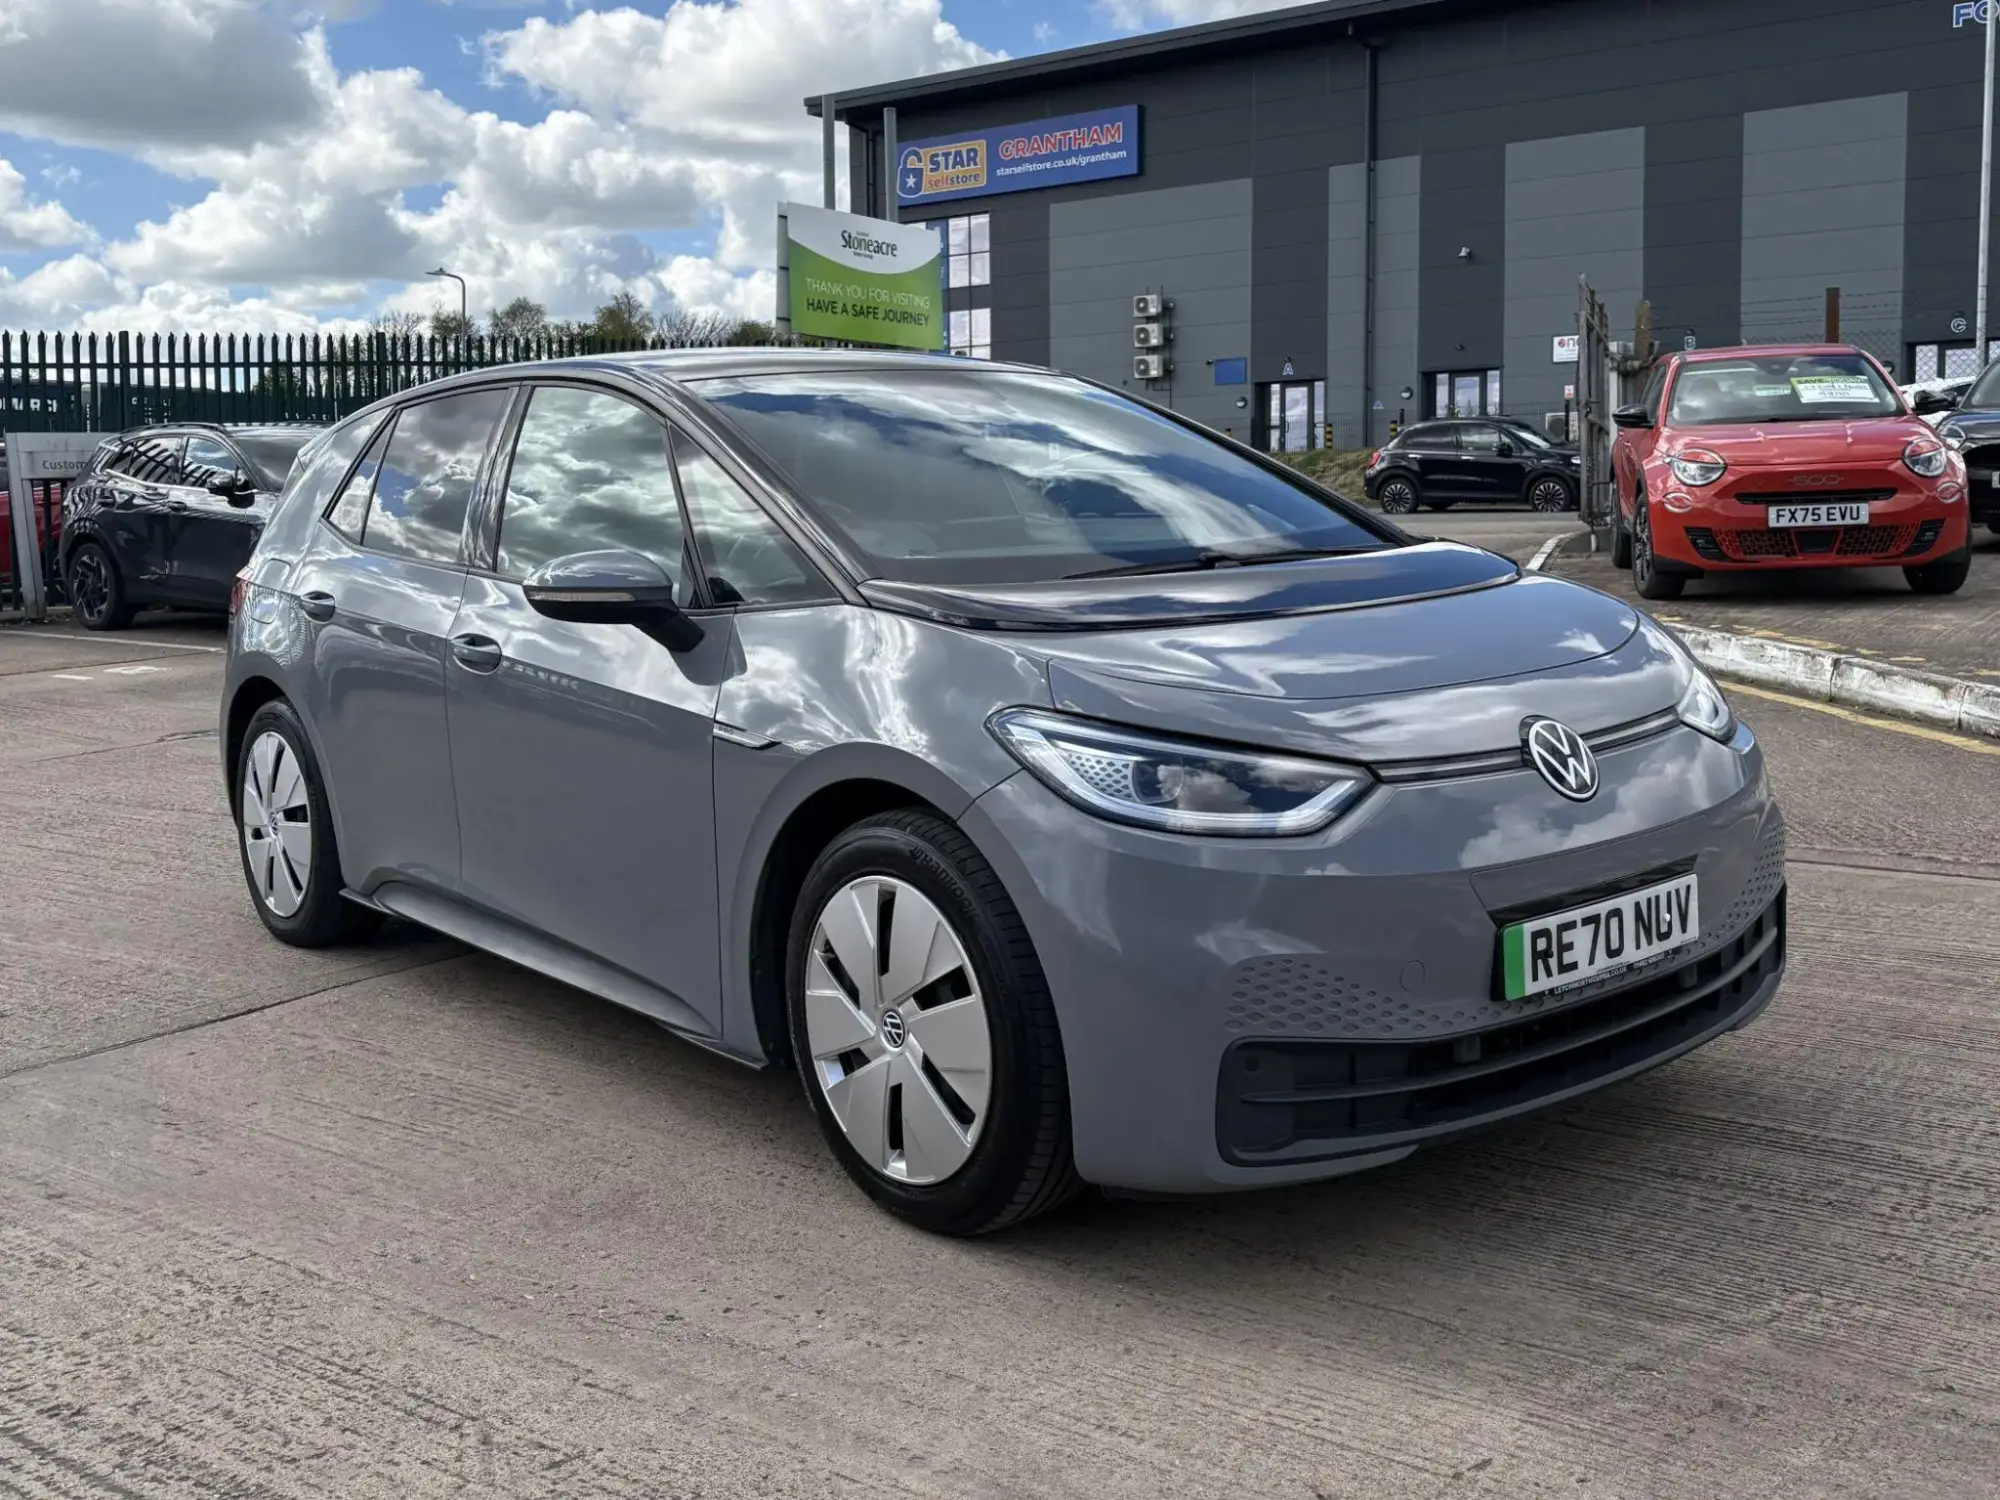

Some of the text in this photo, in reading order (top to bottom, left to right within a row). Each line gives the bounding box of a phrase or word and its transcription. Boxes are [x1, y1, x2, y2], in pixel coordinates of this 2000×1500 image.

[999, 122, 1124, 160] GRANTHAM
[928, 146, 980, 174] STAR
[996, 150, 1127, 177] starselfstore.co.uk/grantham
[928, 173, 981, 188] selfstore
[841, 229, 898, 257] Stoneacre
[805, 278, 930, 309] THANK YOU FOR VISITING
[806, 298, 930, 327] HAVE A SAFE JOURNEY
[1951, 317, 1967, 333] C
[1282, 362, 1294, 376] A
[1776, 505, 1860, 524] FX75 EVU
[1531, 884, 1692, 983] RE70 NUV
